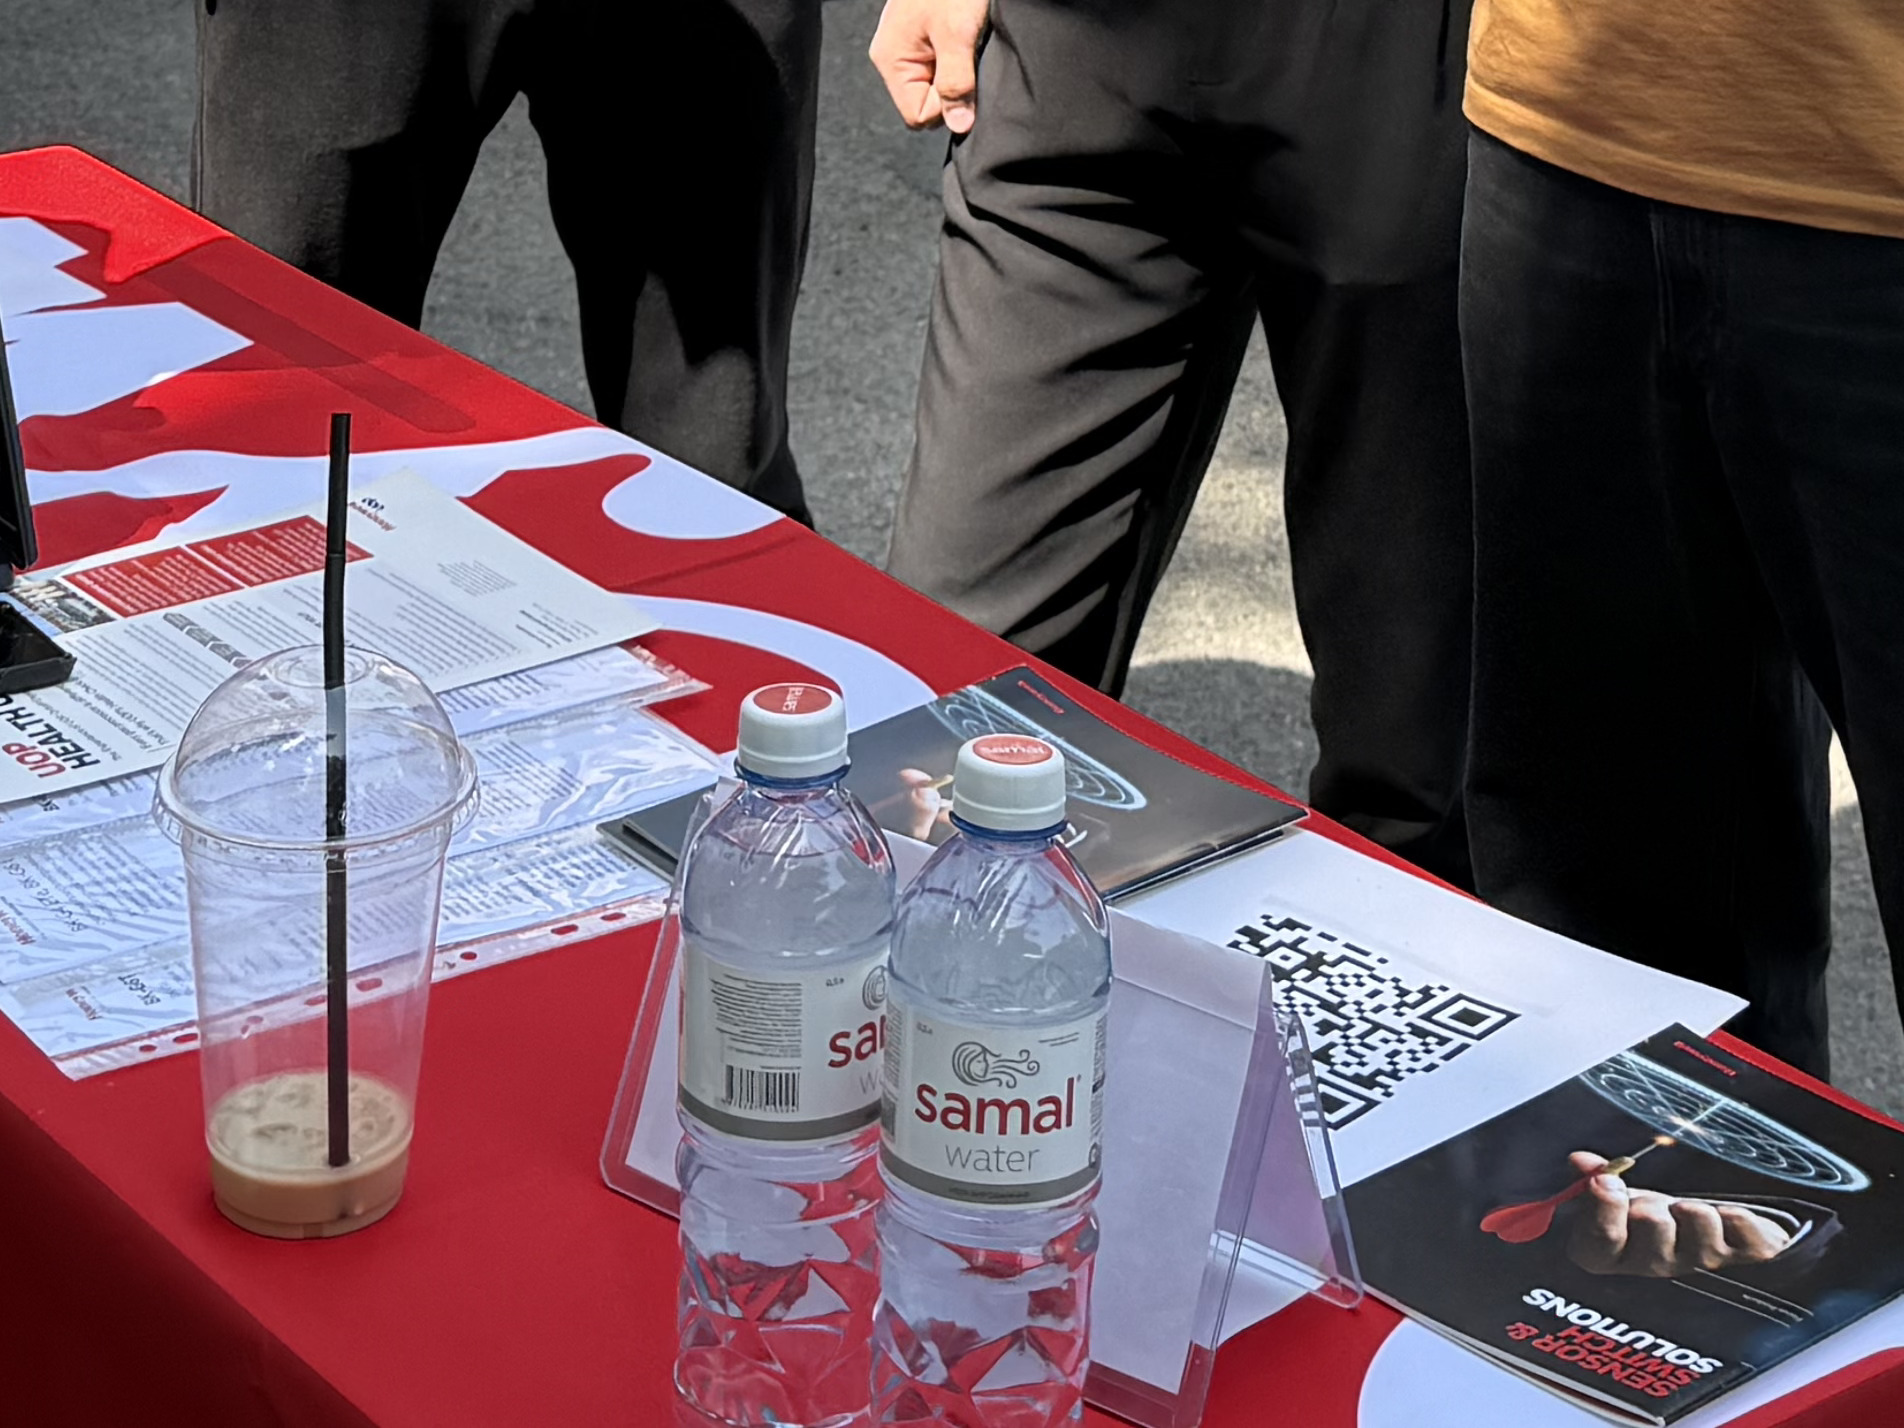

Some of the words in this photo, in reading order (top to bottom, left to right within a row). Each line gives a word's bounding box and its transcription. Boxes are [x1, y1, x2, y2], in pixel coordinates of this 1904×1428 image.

[1, 742, 67, 779] UOP
[914, 1076, 1075, 1136] samal
[945, 1143, 1041, 1174] water
[1504, 1321, 1540, 1341] &
[1521, 1287, 1724, 1375] SOLUTIONS
[1557, 1324, 1702, 1388] SWITCH
[1530, 1334, 1680, 1398] SENSOR
